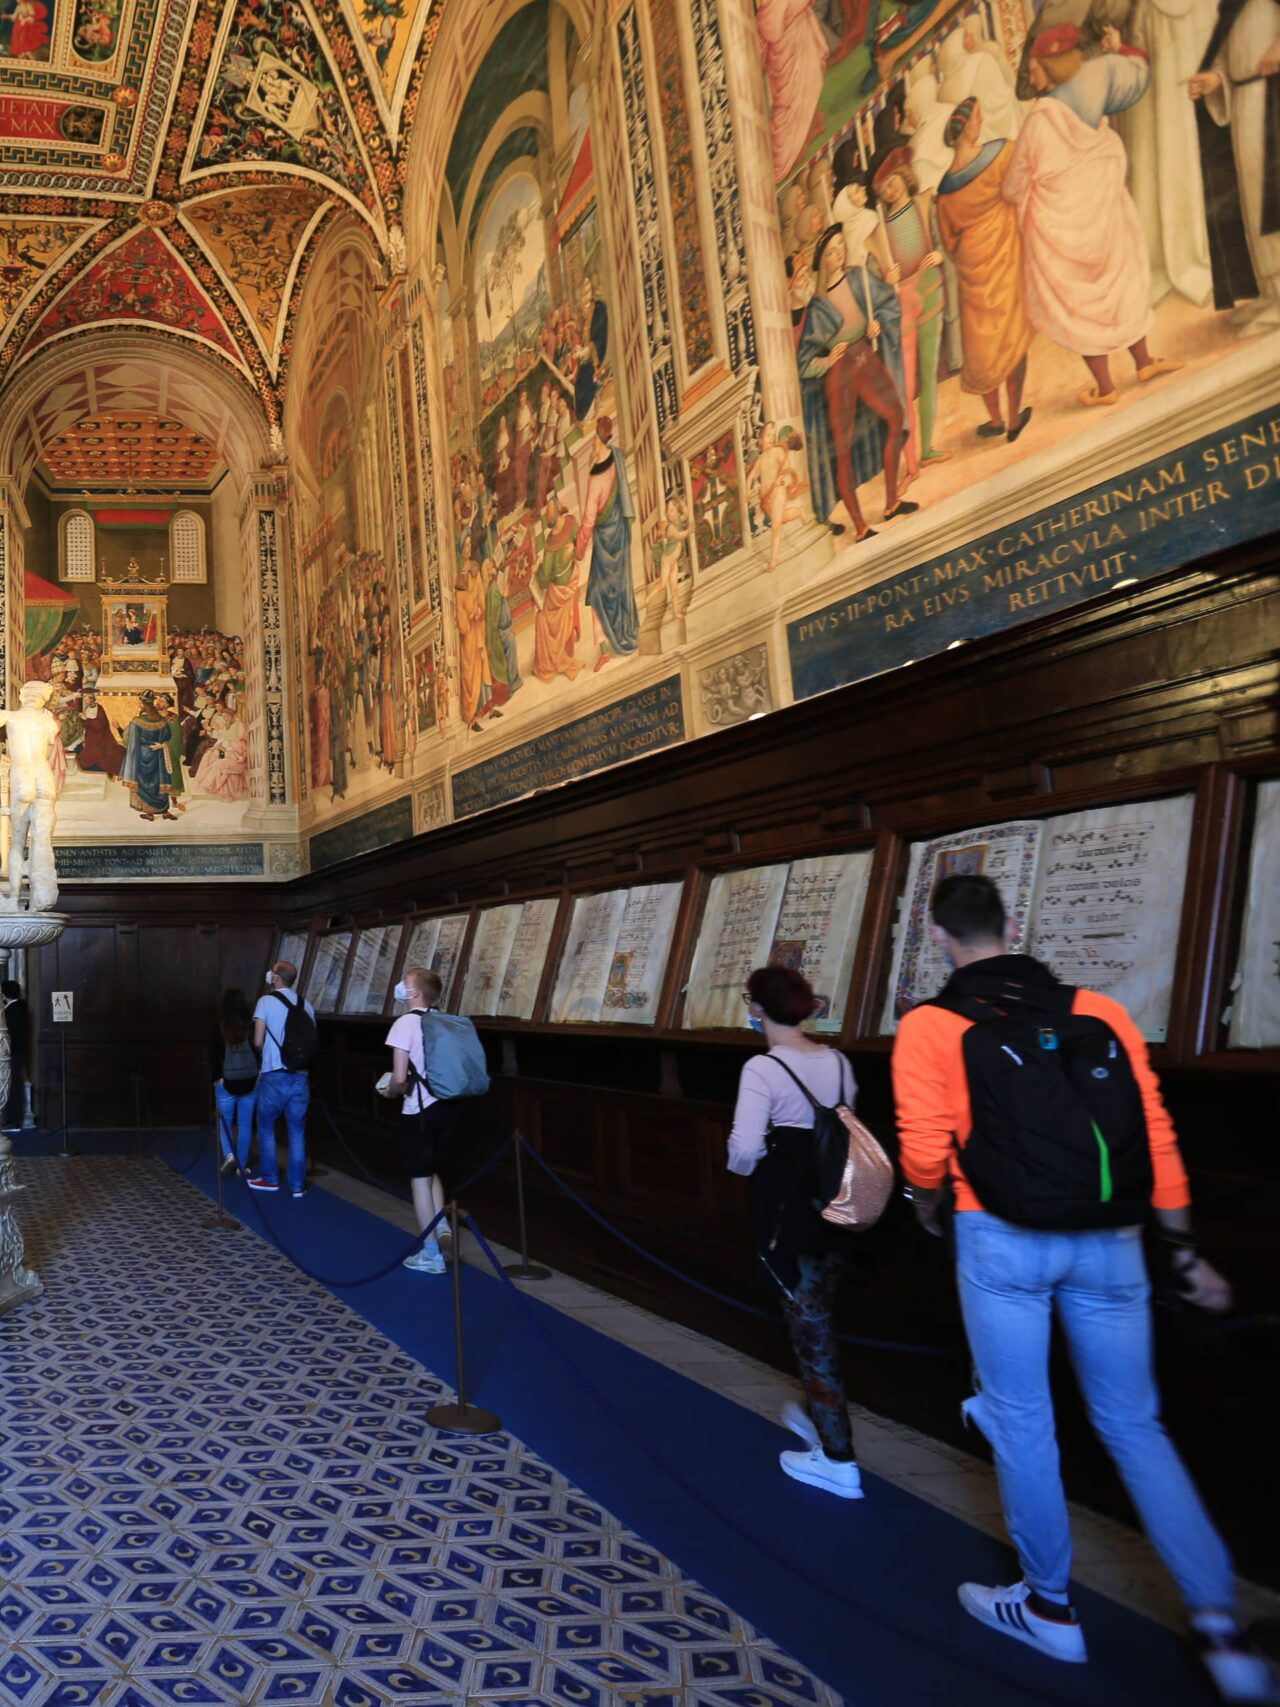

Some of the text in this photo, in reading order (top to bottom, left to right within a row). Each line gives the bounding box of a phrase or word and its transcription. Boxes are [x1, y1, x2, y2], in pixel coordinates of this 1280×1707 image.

[10, 117, 57, 135] MAX
[798, 610, 838, 642] PIVS
[846, 602, 859, 622] II
[866, 574, 922, 613] PONT
[932, 545, 988, 586] MAX
[997, 458, 1186, 560] CATHERINAM
[883, 604, 915, 632] RA
[923, 581, 970, 617] EIVS
[982, 517, 1128, 594] MIRACVLA
[1138, 474, 1232, 533] INTER
[659, 684, 672, 699] IN
[662, 701, 679, 718] AD
[80, 848, 117, 856] ANTISTES
